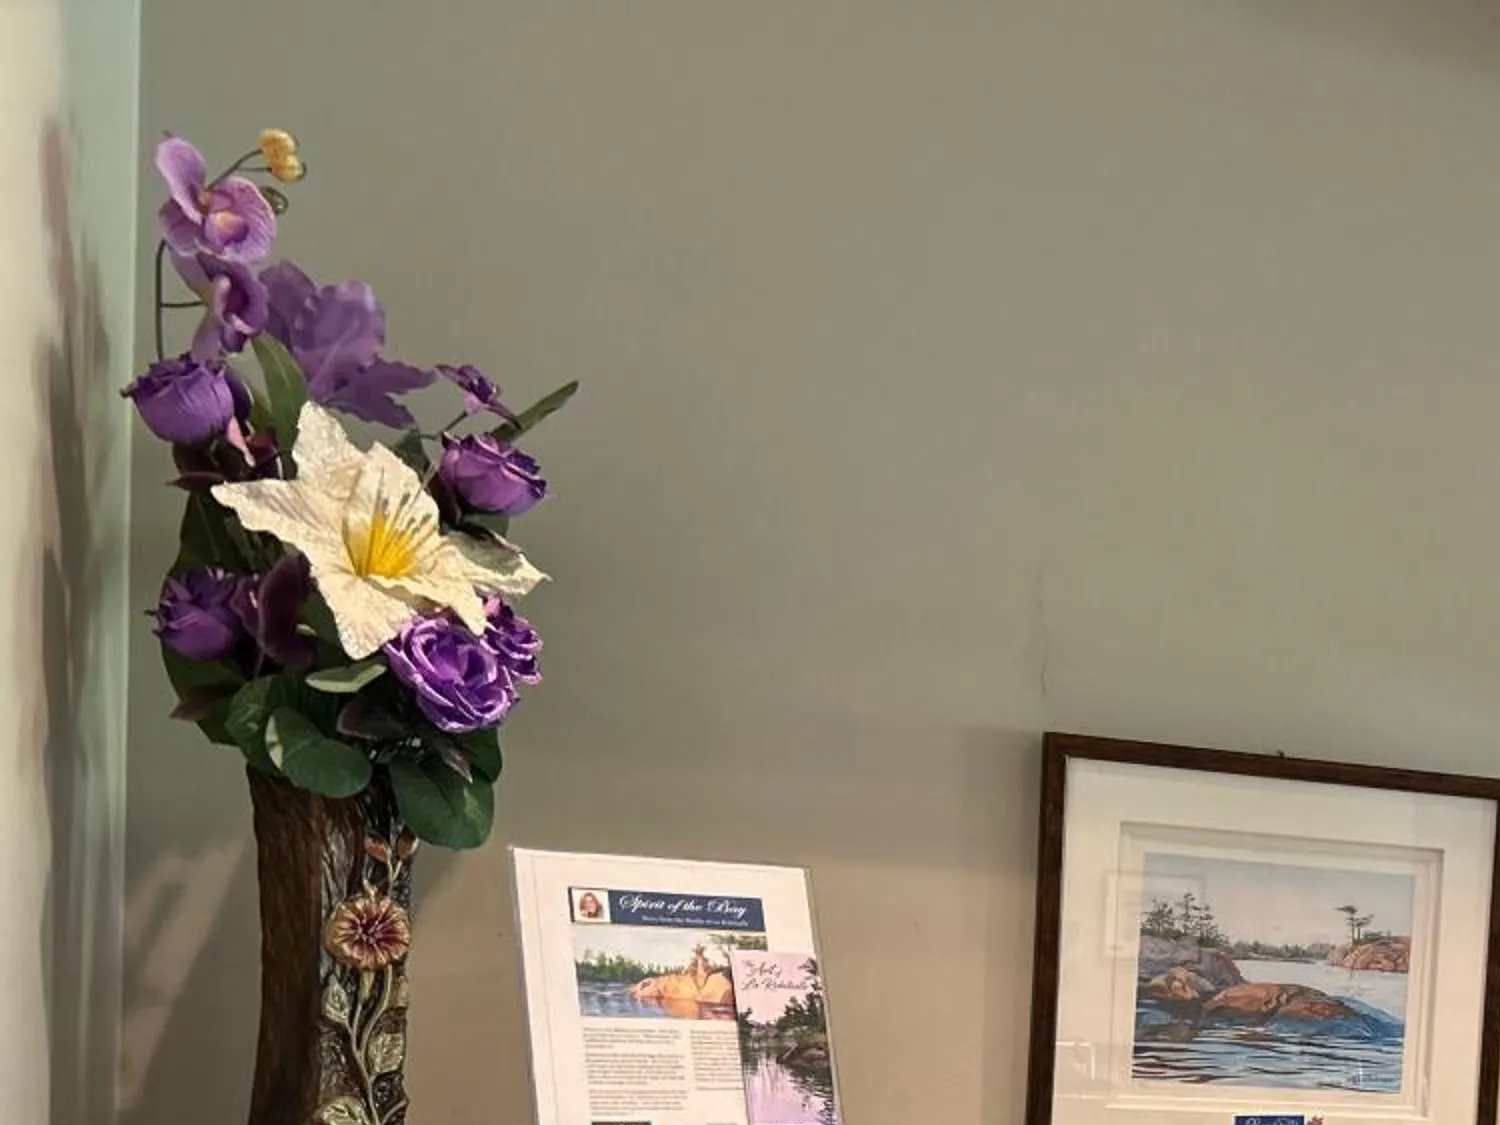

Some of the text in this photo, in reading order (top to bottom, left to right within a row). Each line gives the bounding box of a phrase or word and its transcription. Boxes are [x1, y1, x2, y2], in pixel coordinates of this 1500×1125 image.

[619, 895, 747, 918] Spirit of the Bay
